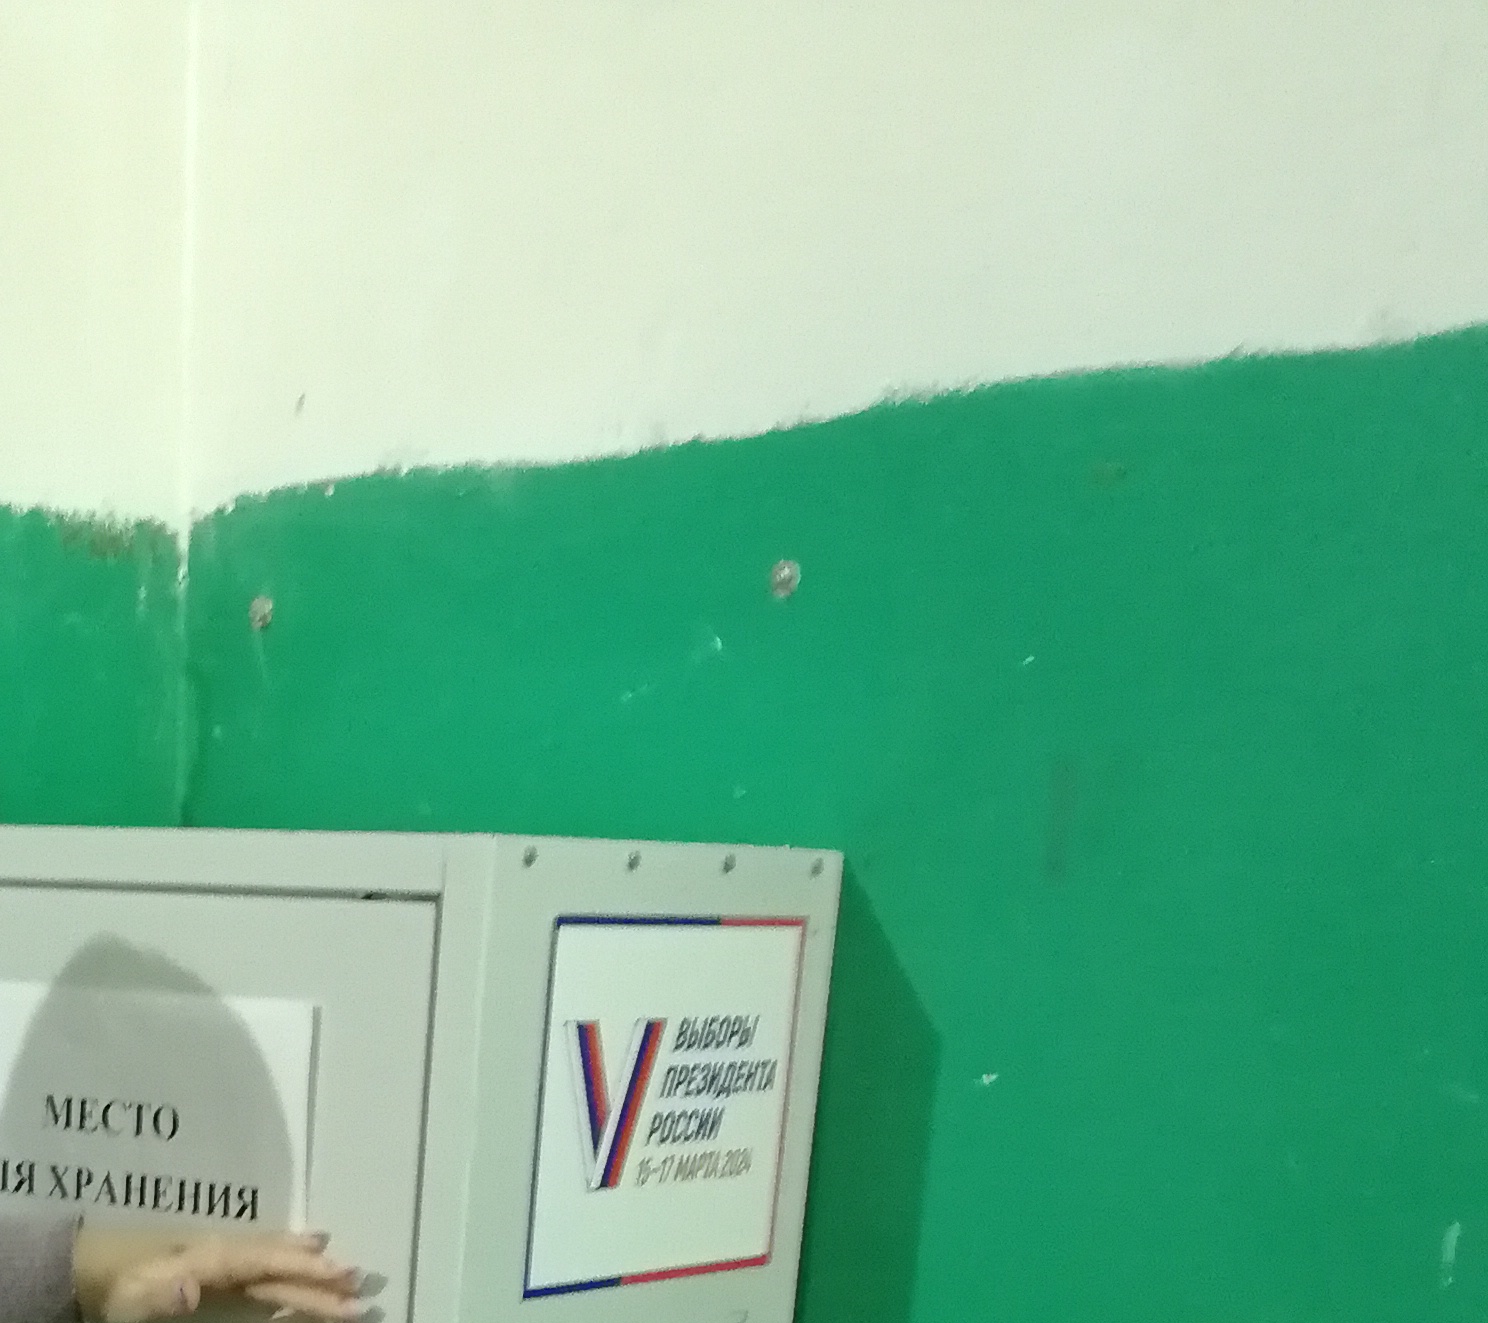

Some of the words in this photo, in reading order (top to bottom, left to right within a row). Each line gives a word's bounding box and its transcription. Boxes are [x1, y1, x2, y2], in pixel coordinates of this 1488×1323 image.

[674, 1016, 759, 1052] ВЫБОРЫ
[659, 1059, 778, 1099] ПРЕЗИДЕНТА
[44, 1094, 181, 1141] МЕСТО
[646, 1107, 726, 1146] РОССИИ
[48, 1163, 261, 1221] ХРАНЕНИЯ
